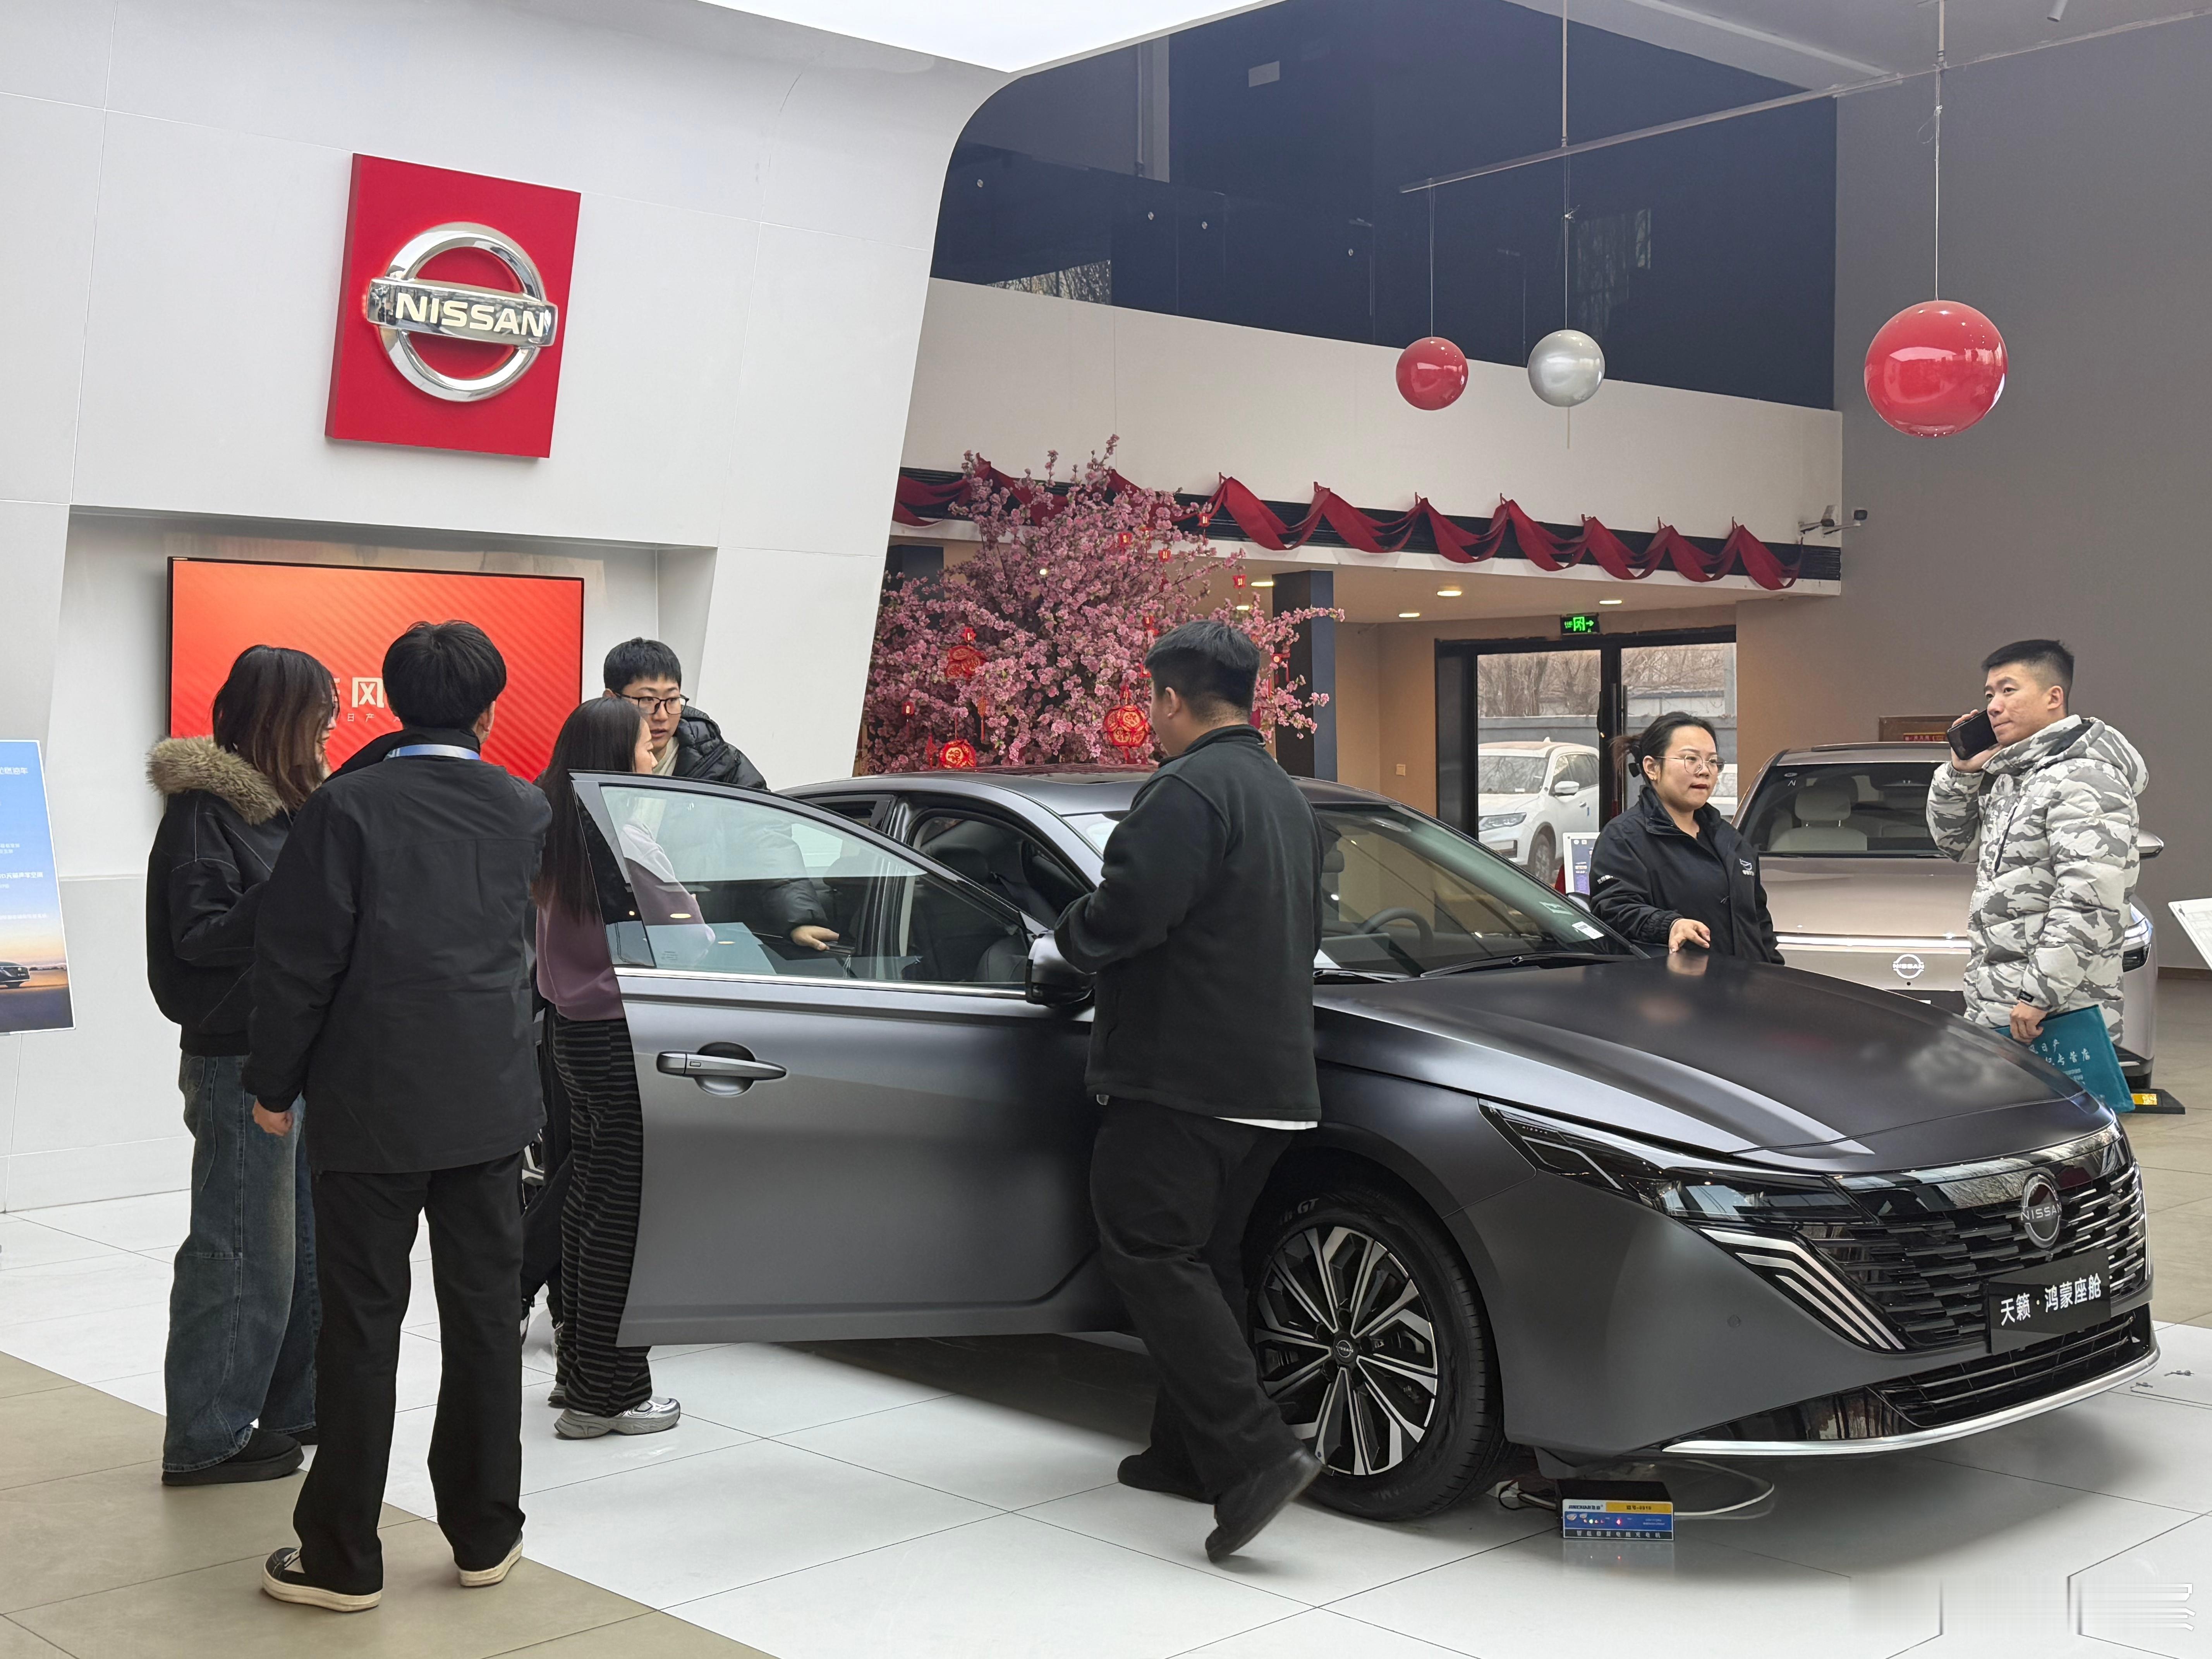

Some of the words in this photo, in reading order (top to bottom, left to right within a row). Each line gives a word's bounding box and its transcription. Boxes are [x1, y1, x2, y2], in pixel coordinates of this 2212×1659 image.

[395, 293, 544, 337] NISSAN
[334, 677, 384, 708] 风
[347, 713, 374, 722] 日产
[2020, 1203, 2062, 1221] NISSAN
